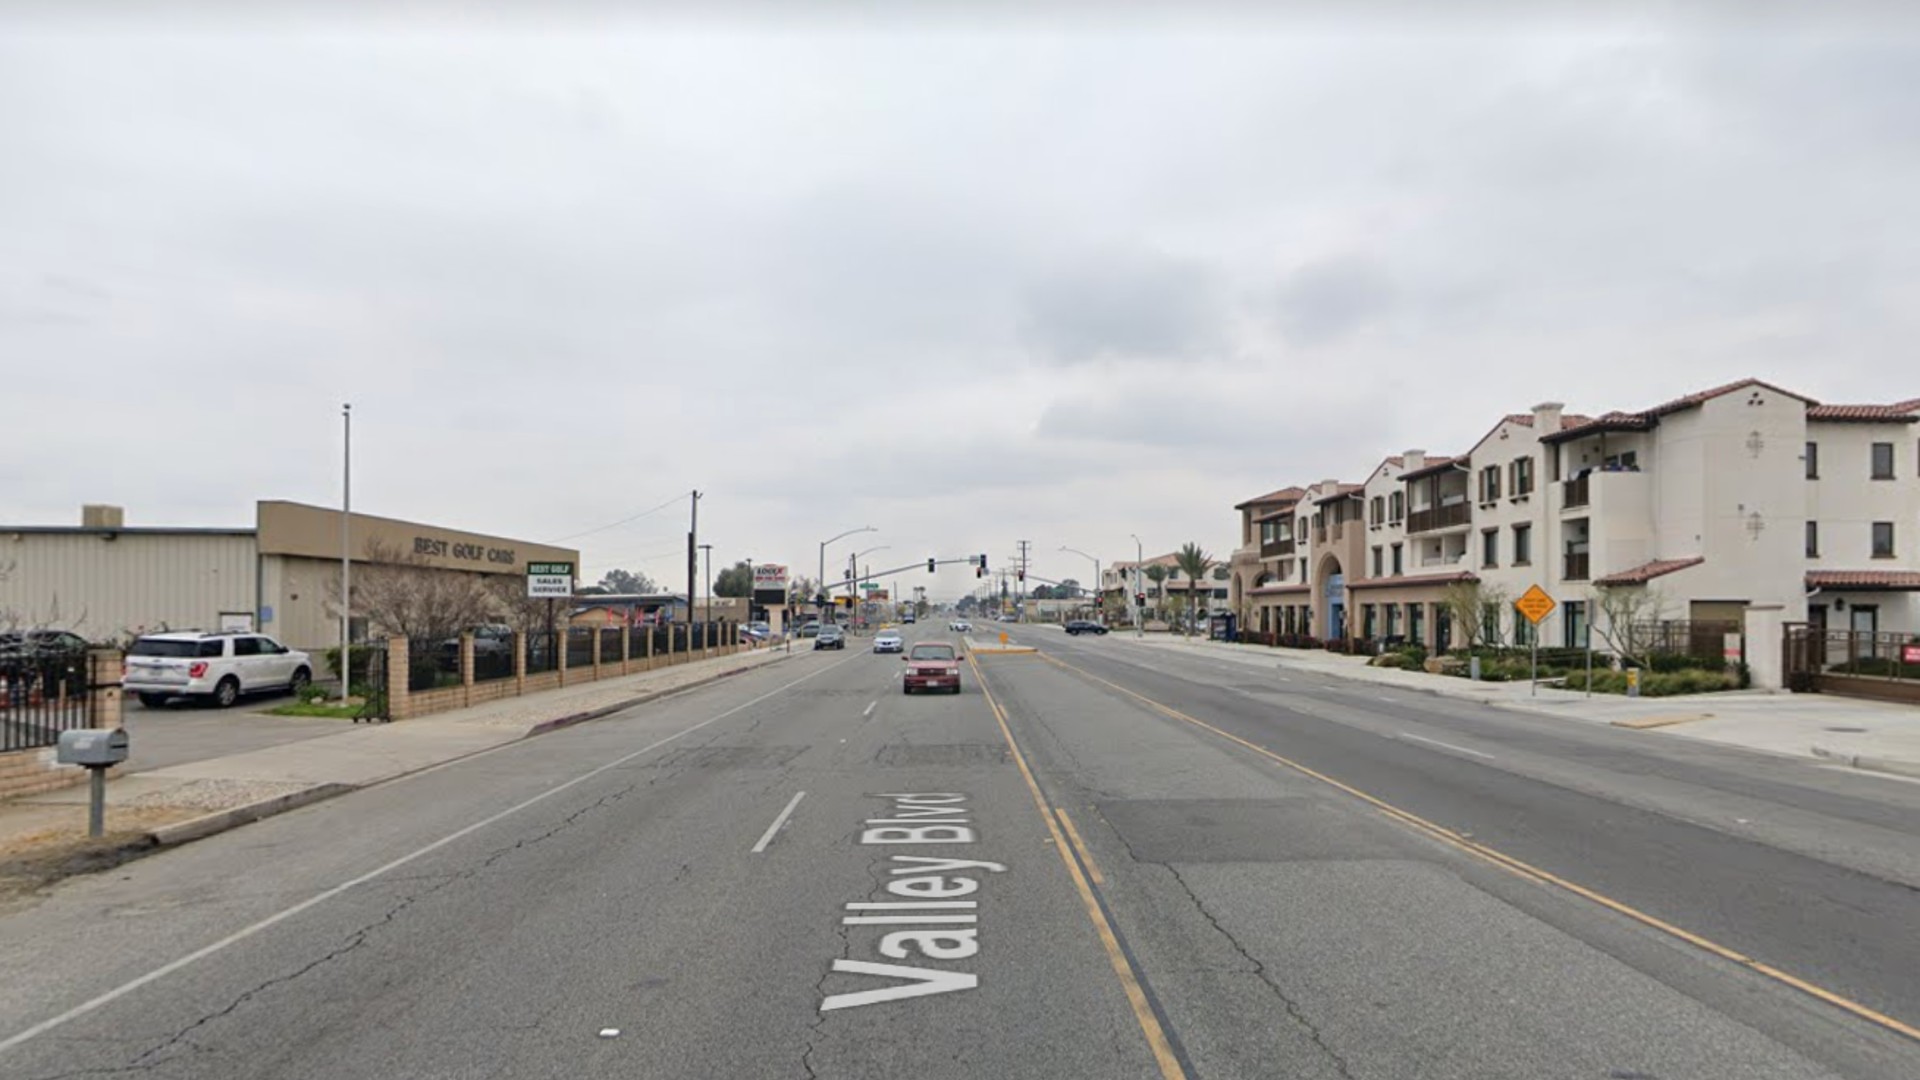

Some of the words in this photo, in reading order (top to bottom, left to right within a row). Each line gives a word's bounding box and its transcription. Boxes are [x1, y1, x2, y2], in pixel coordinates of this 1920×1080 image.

[413, 537, 448, 557] BEST
[452, 542, 484, 560] GOLF
[487, 547, 515, 564] CARS
[530, 564, 549, 573] BEST
[551, 564, 570, 573] GOLF
